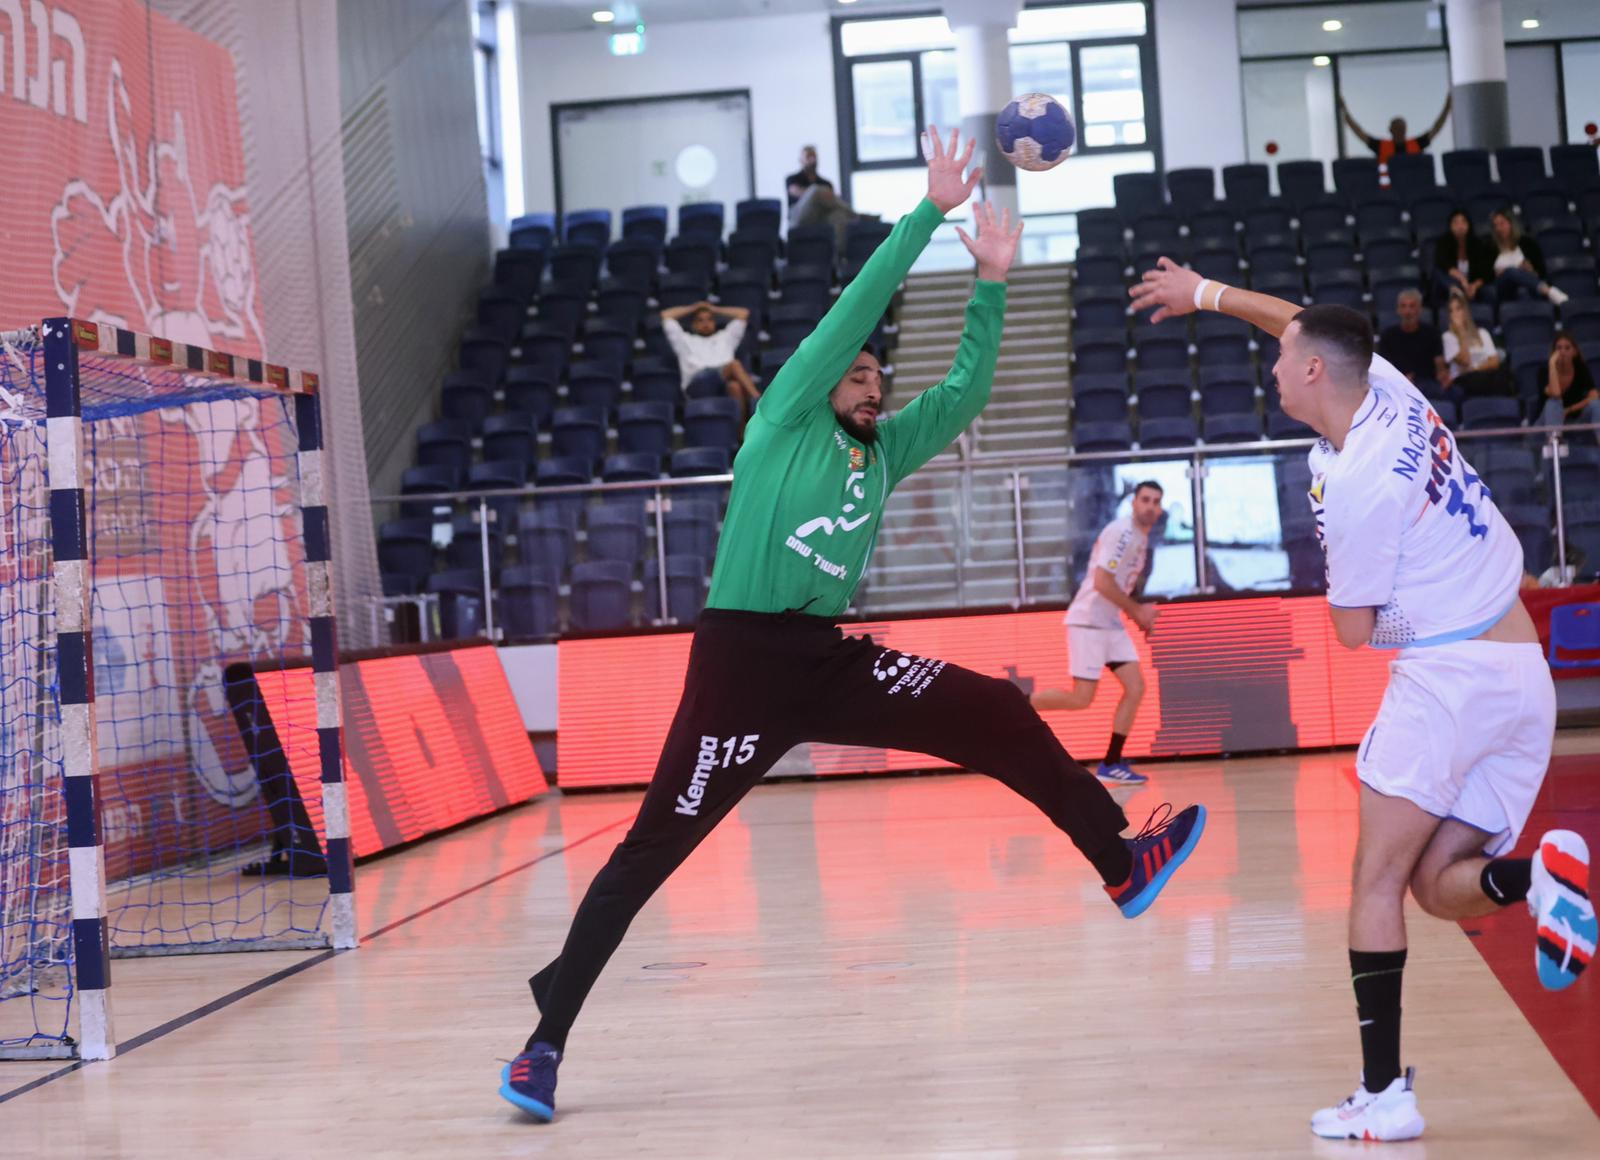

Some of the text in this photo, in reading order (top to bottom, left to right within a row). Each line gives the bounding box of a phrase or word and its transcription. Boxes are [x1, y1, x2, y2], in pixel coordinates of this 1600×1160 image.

[785, 536, 812, 557] שחם
[722, 734, 760, 768] 15
[675, 735, 720, 816] Kempa
